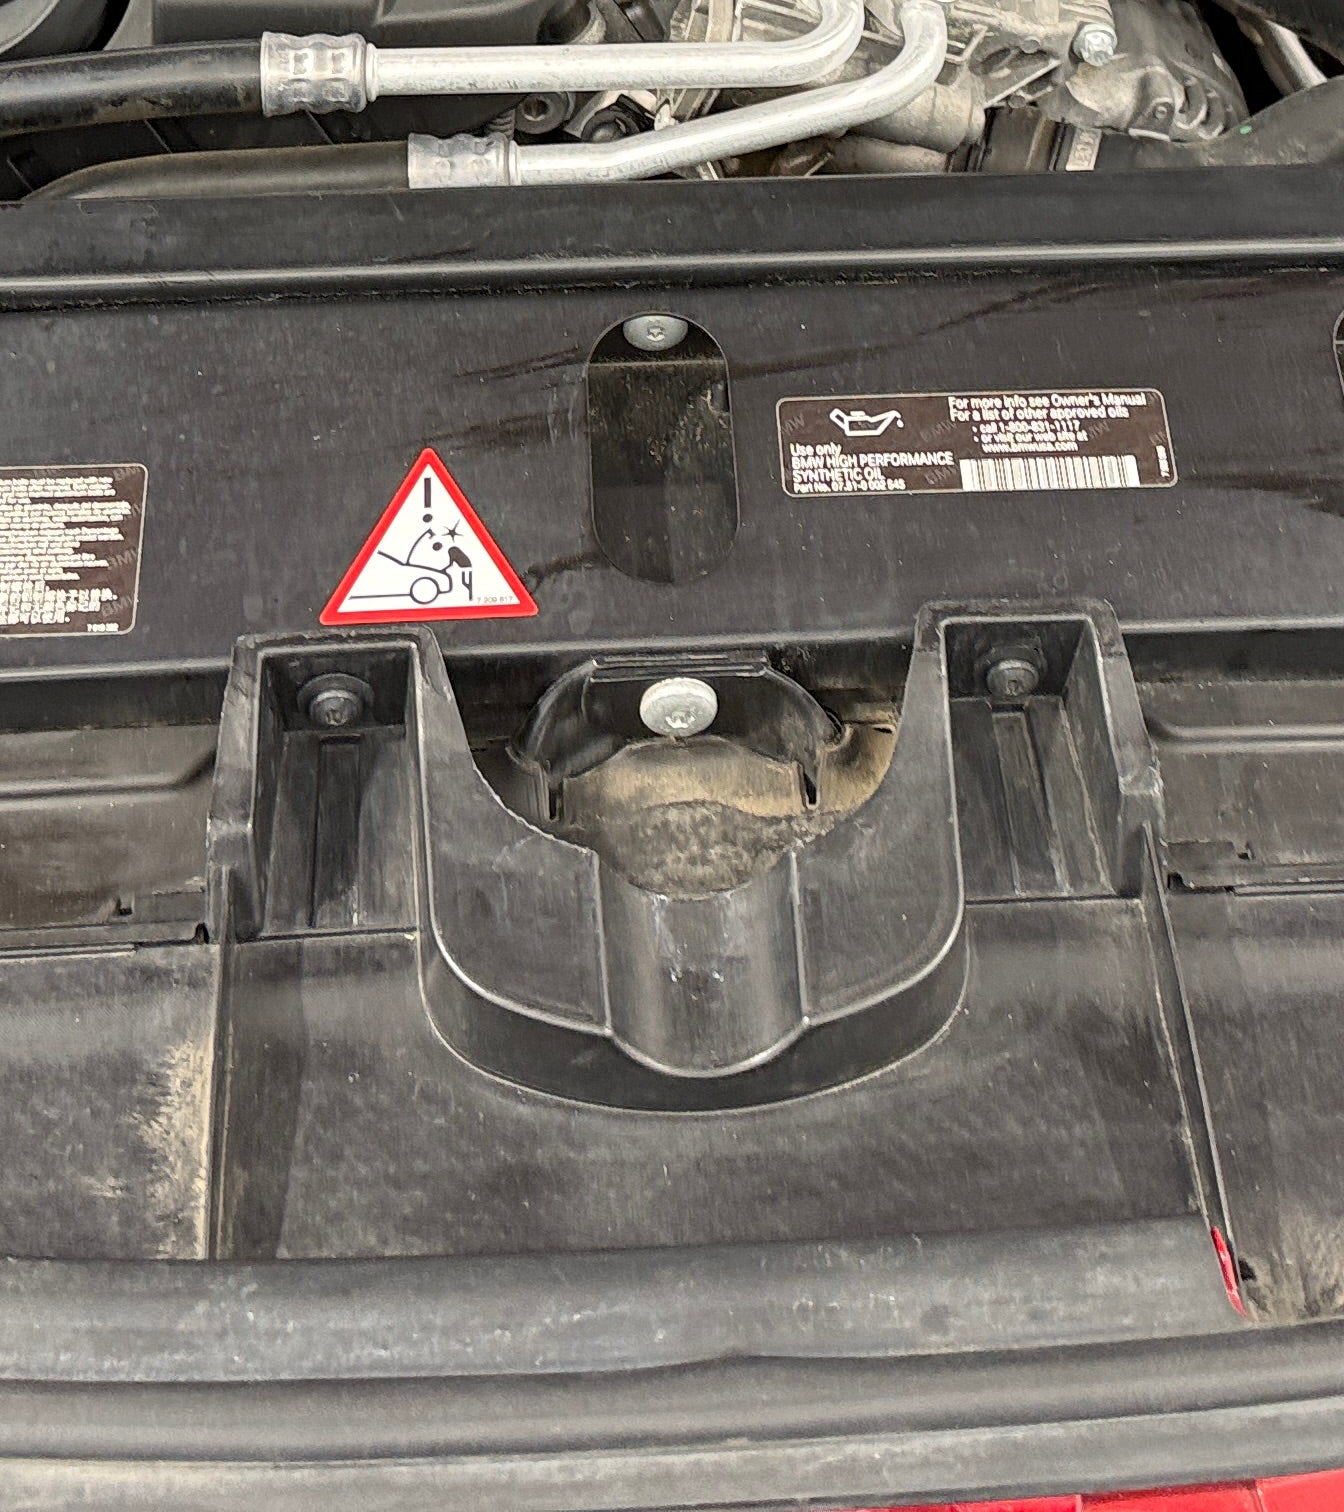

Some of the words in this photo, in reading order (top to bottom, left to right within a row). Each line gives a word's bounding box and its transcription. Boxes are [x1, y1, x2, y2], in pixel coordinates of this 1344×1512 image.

[948, 396, 969, 409] For
[971, 397, 1002, 409] more
[1003, 394, 1027, 407] info
[1028, 396, 1050, 407] see
[1051, 393, 1101, 406] Owner's
[1102, 392, 1147, 405] Manual
[950, 409, 971, 422] For
[972, 411, 981, 421] a
[982, 408, 1000, 421] list
[1001, 408, 1016, 420] of
[1016, 407, 1049, 420] other
[1050, 406, 1106, 421] approved
[1108, 406, 1130, 418] oils
[980, 421, 998, 433] call
[981, 433, 993, 443] or
[994, 431, 1014, 443] visit
[1014, 432, 1032, 442] our
[1033, 431, 1056, 442] web
[1057, 430, 1075, 441] site
[1076, 430, 1088, 441] at
[790, 443, 814, 457] Use
[816, 442, 842, 458] only
[982, 441, 1079, 454] www.bmwusa.com
[791, 456, 824, 469] BMW
[827, 454, 857, 468] HIGH
[859, 451, 954, 467] PERFORMANCE
[793, 468, 862, 483] SYNTHETIC
[864, 467, 885, 480] OIL
[794, 482, 814, 493] Part
